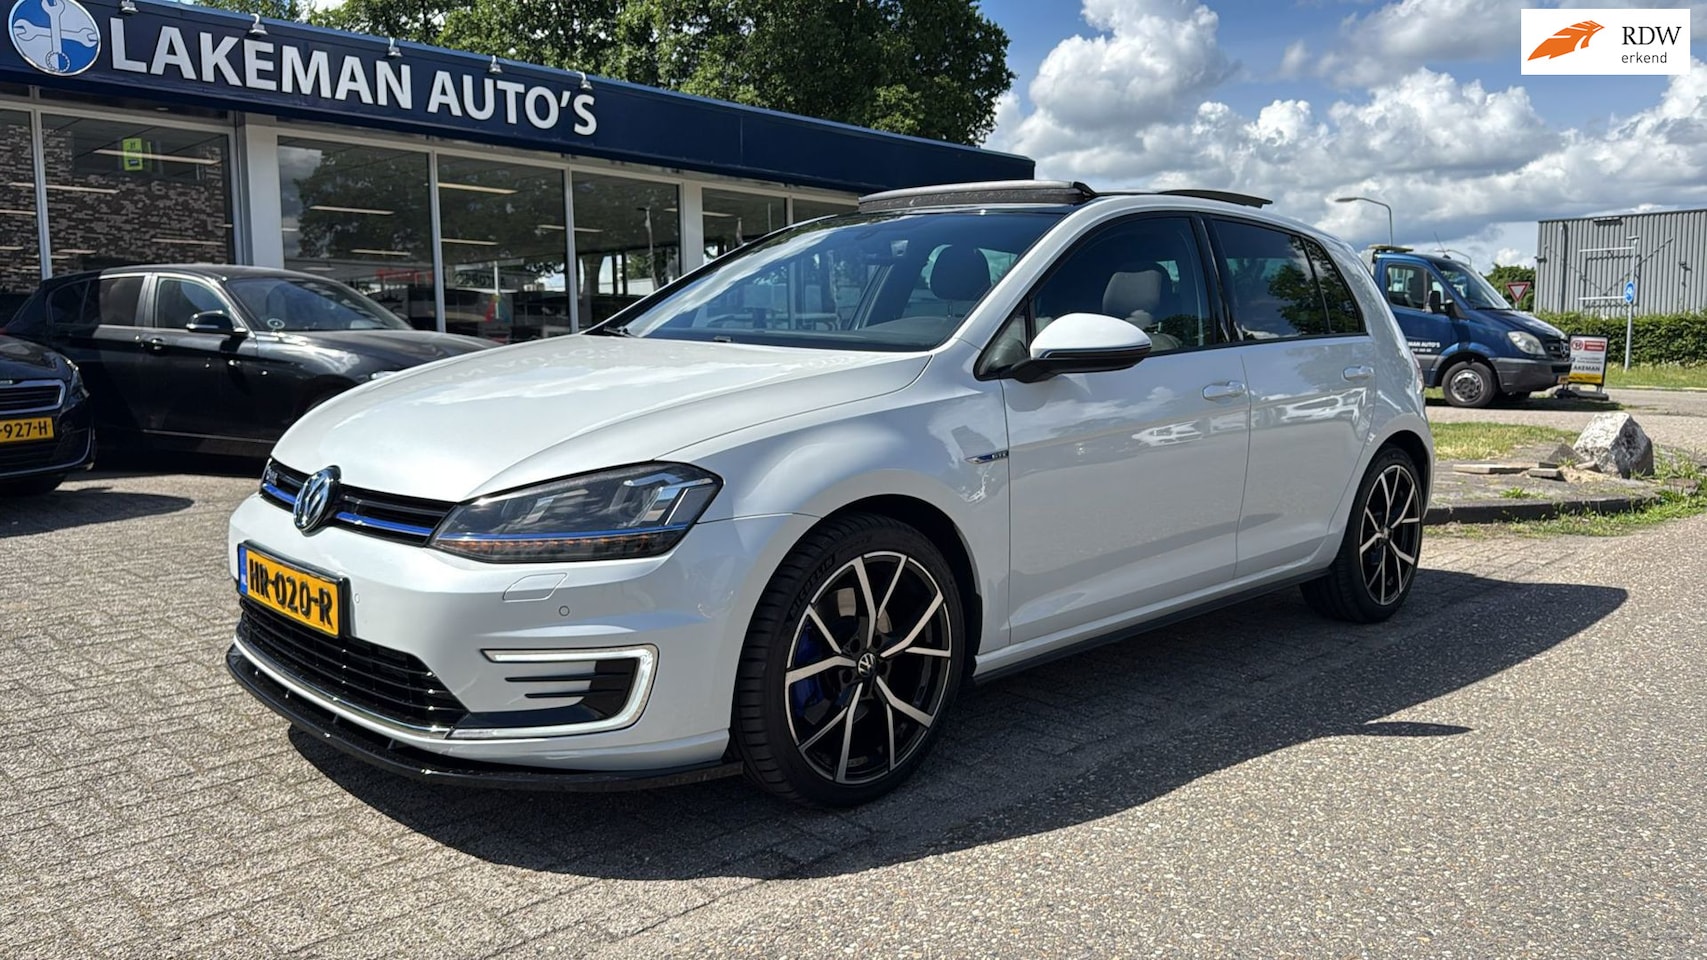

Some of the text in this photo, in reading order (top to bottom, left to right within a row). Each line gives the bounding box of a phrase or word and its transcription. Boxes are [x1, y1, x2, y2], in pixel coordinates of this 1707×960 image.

[109, 16, 598, 136] LAKEMAN AUTO'S
[249, 558, 334, 631] HR-020-R
